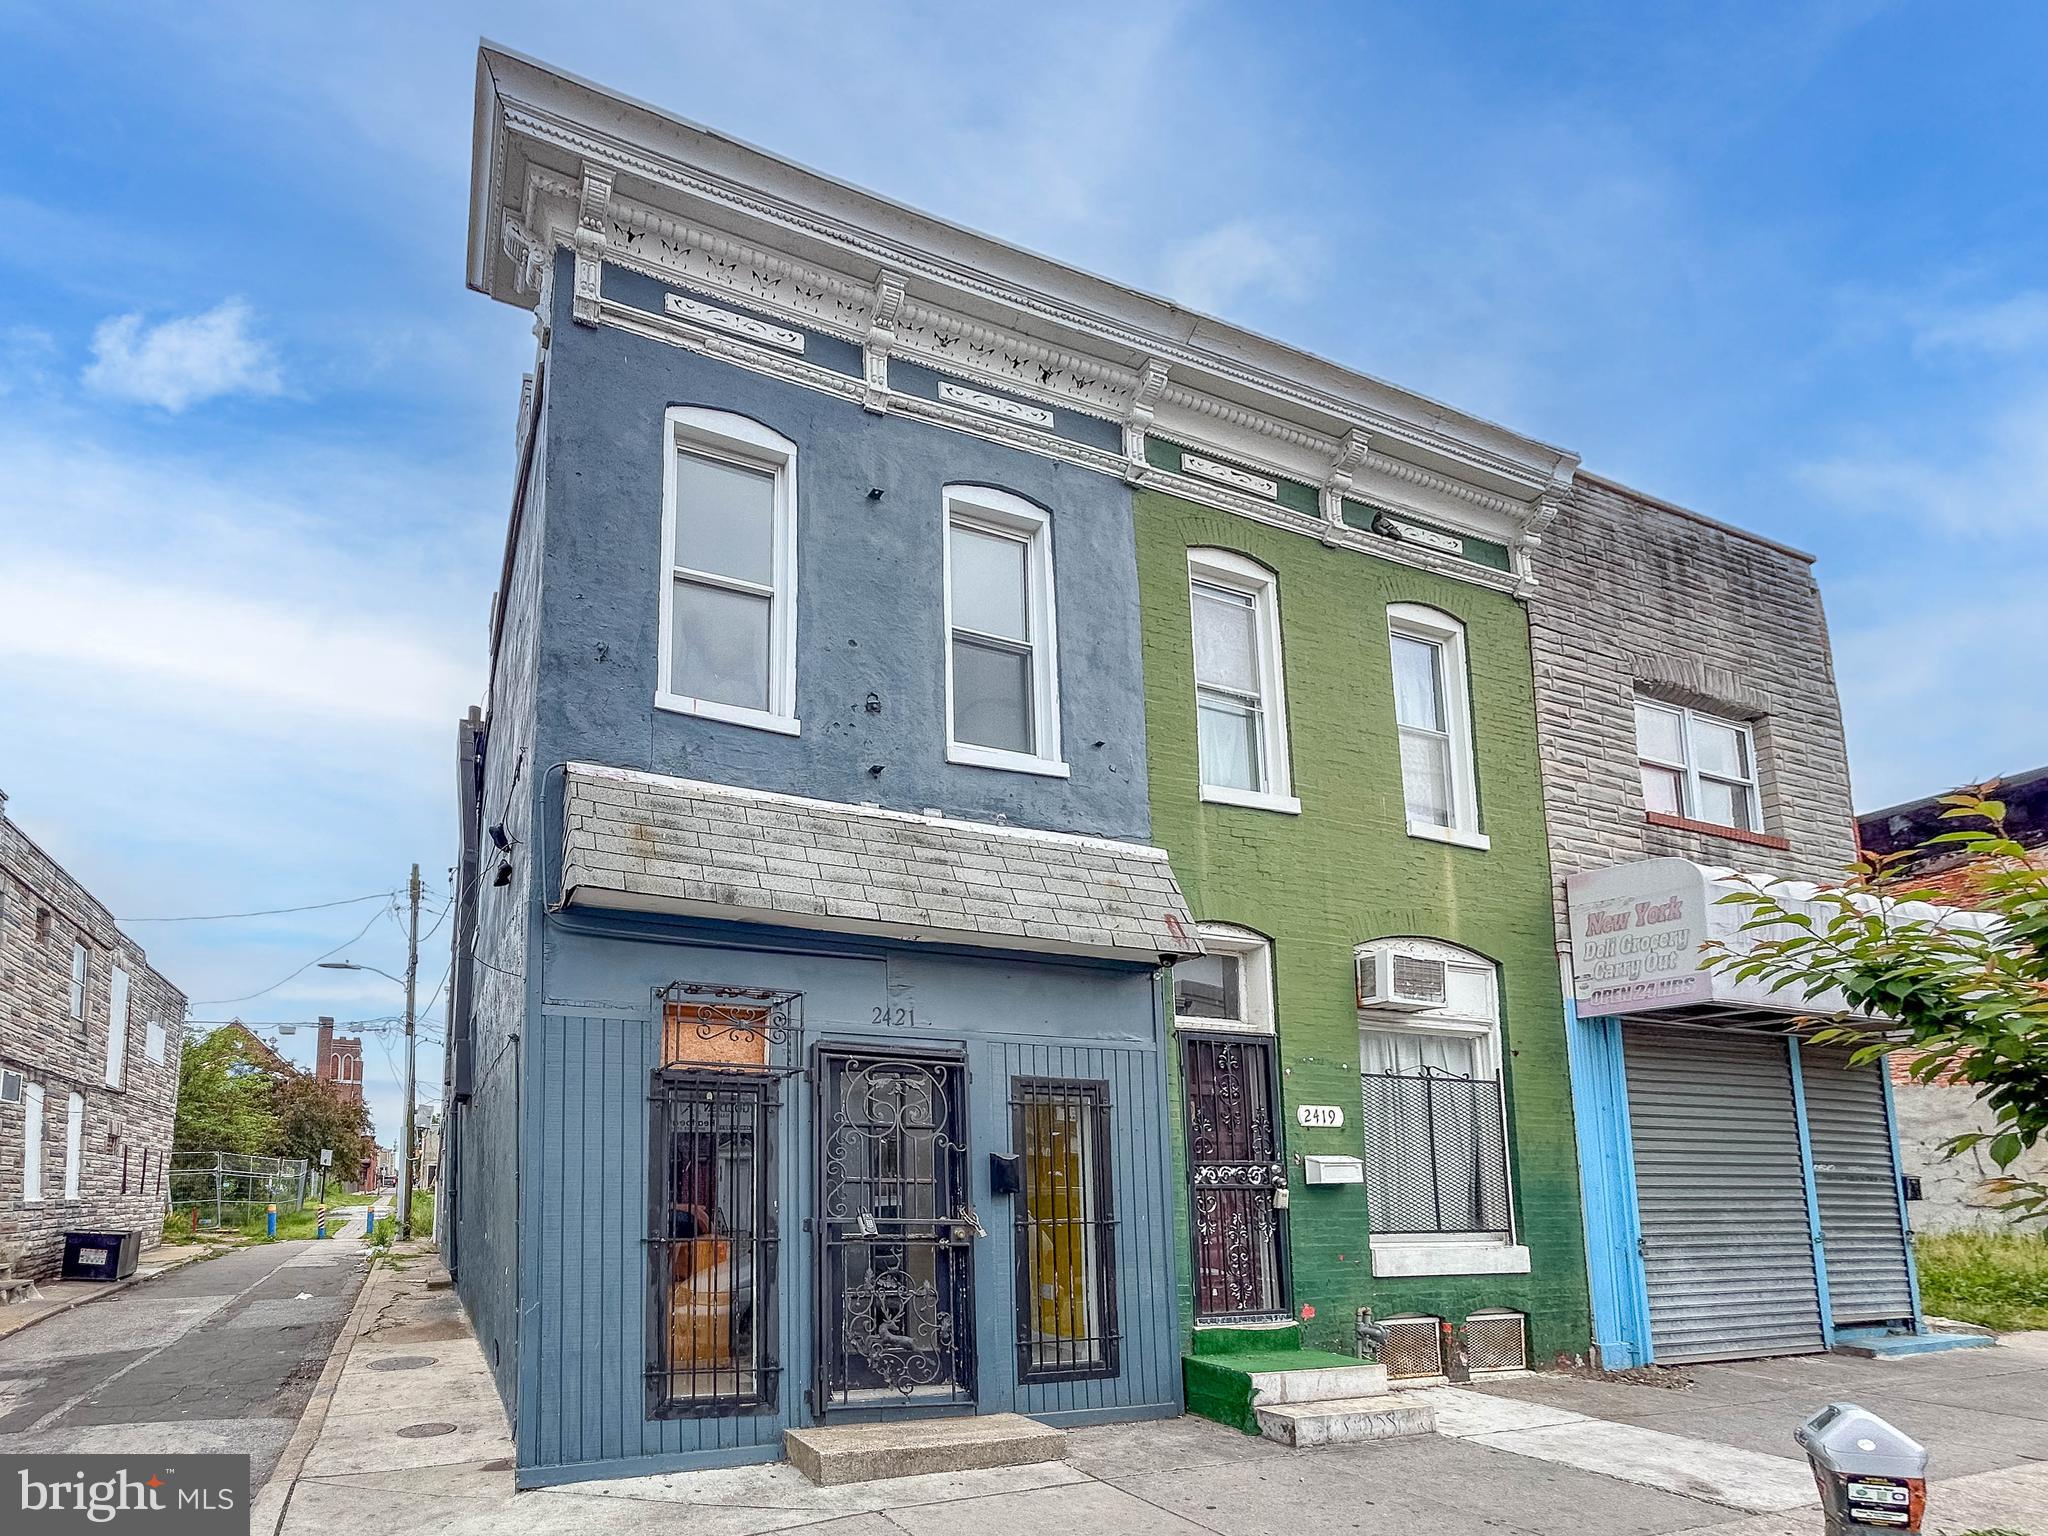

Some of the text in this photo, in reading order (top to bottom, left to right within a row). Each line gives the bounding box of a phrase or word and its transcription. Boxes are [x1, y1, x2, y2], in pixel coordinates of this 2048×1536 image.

[1585, 896, 1683, 937] New York
[1583, 928, 1689, 962] Deli Grocery
[1593, 951, 1679, 981] Carry Out
[1590, 977, 1696, 1006] OPEN 24 HRS
[872, 1006, 914, 1027] 2421
[1304, 1108, 1336, 1125] 2419
